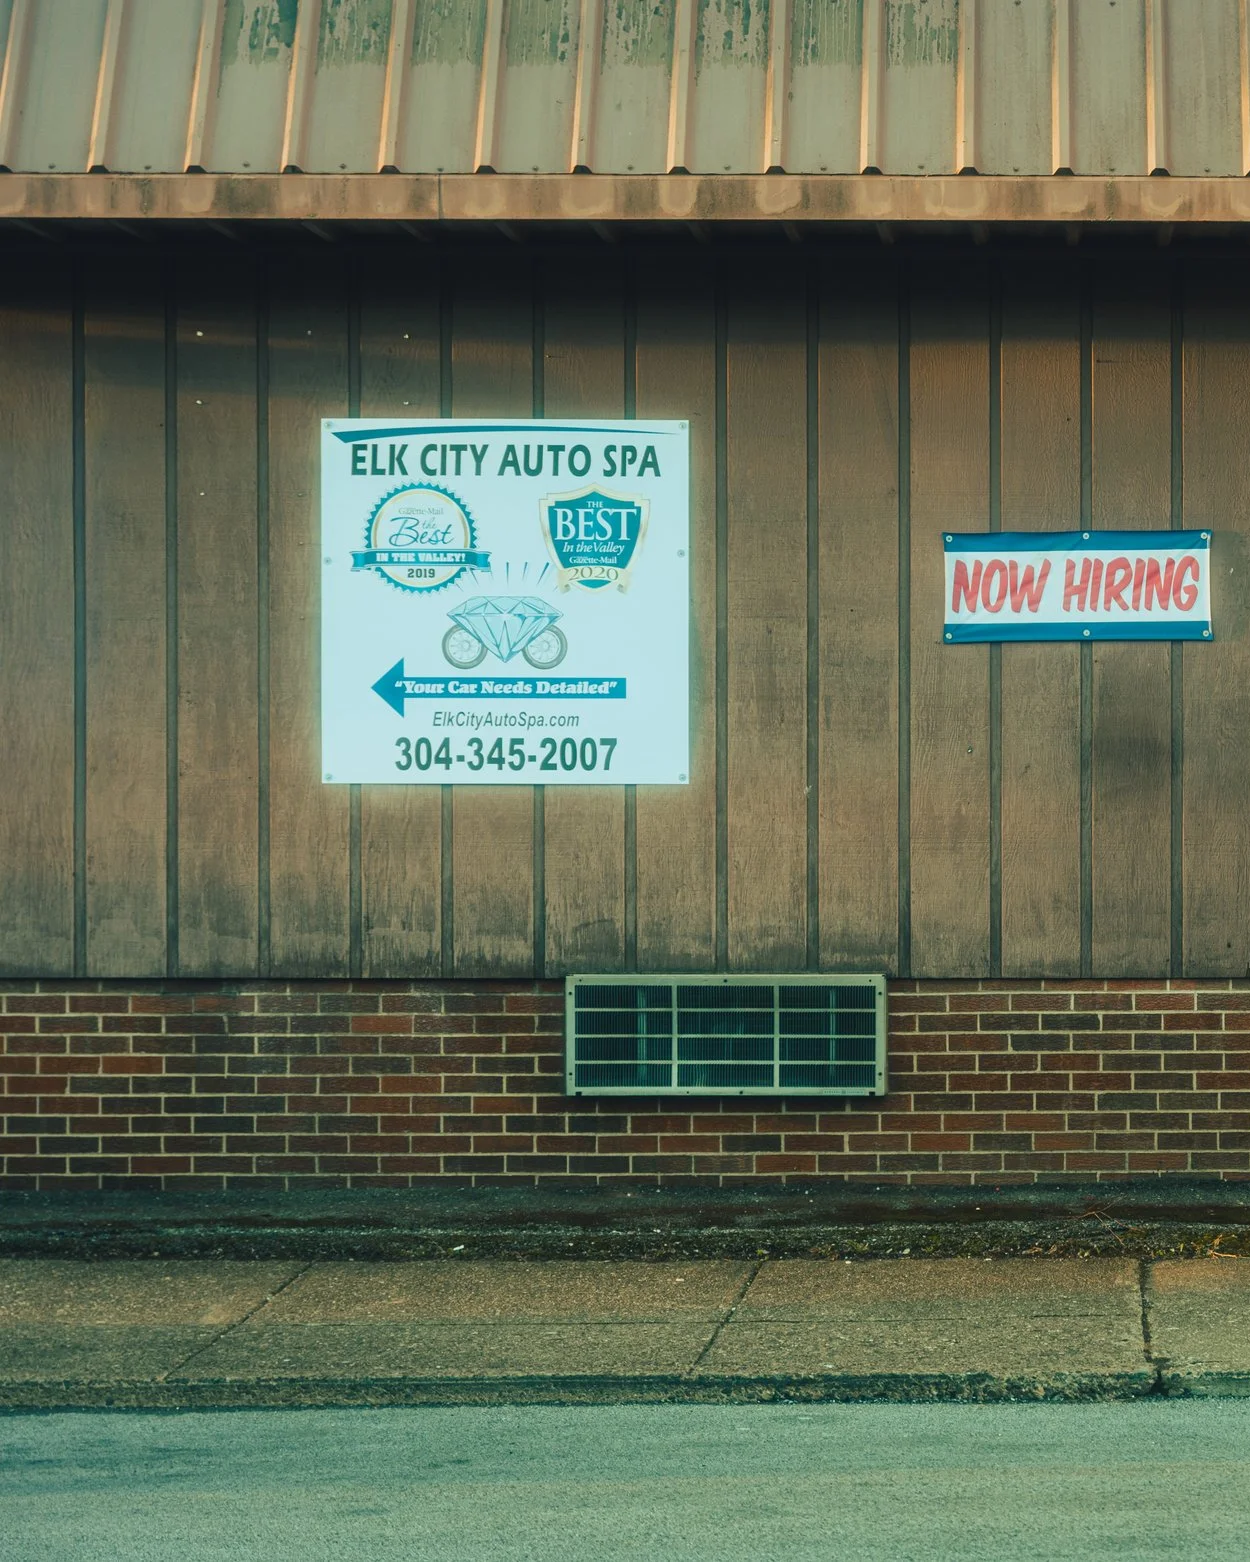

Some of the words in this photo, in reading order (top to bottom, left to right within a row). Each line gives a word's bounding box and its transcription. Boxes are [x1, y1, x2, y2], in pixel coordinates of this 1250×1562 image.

[351, 444, 408, 476] ELK
[420, 444, 489, 476] CITY
[497, 444, 592, 477] AUTO
[603, 445, 662, 477] SPA
[389, 516, 455, 547] Best
[553, 508, 637, 541] BEST
[375, 553, 389, 562] IN
[391, 553, 415, 562] THE
[418, 553, 466, 562] VALLEY!
[563, 541, 574, 553] In
[575, 541, 593, 553] the
[593, 541, 625, 556] Valley
[407, 568, 436, 578] 2019
[567, 566, 619, 582] 2020
[952, 558, 1052, 614] NOW
[1062, 555, 1200, 613] HIRING
[447, 680, 478, 695] Car
[480, 680, 533, 695] Needs
[432, 711, 580, 730] ElkCityAutoSpa.com
[394, 736, 618, 772] 304-345-2007
